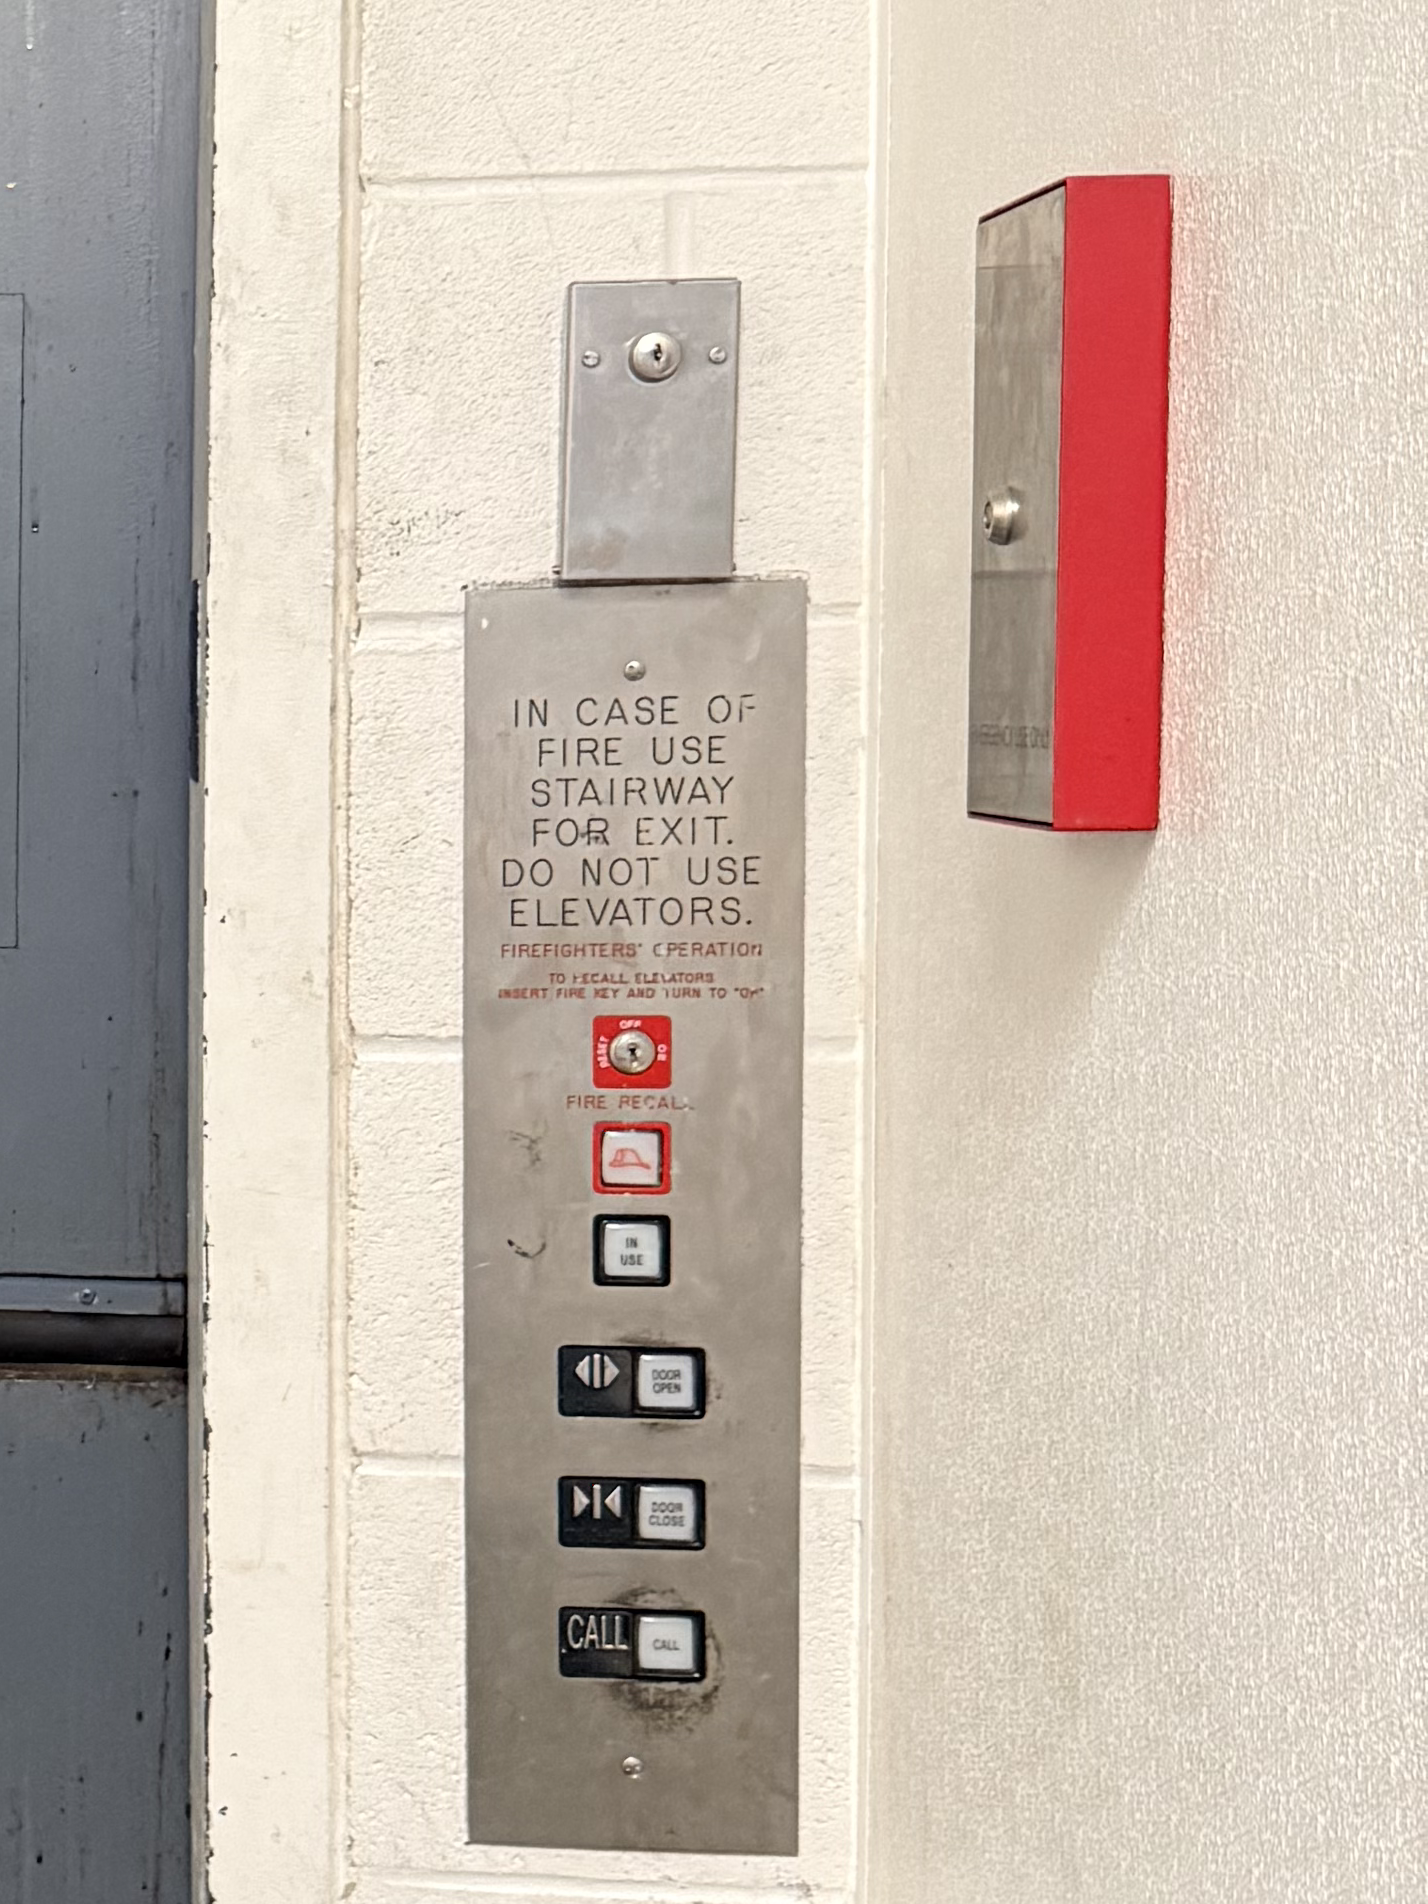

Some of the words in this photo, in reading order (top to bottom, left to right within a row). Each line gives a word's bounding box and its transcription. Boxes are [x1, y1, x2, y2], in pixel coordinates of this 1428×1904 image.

[514, 698, 548, 728] IN
[576, 695, 680, 727] CASE
[707, 693, 757, 724] OF
[538, 736, 624, 768] FIRE
[651, 734, 727, 766] USE
[531, 775, 735, 808] STAIRWAY
[532, 817, 610, 847] FOR
[635, 815, 734, 846] EXIT.
[502, 858, 554, 888] DO
[582, 856, 660, 887] NOT
[687, 855, 762, 886] USE
[510, 895, 753, 928] ELEVATORS.
[548, 972, 566, 985] TO
[555, 987, 587, 1000] FIRE
[626, 986, 656, 999] AND
[709, 986, 728, 999] TO
[566, 1095, 608, 1110] FIRE
[625, 1236, 638, 1248] IN
[620, 1253, 644, 1266] USE
[651, 1368, 682, 1381] DOOR
[652, 1382, 682, 1394] OPEN
[651, 1501, 683, 1514] DOOR
[648, 1514, 685, 1527] CLOSE
[566, 1613, 629, 1650] CALL
[652, 1638, 681, 1651] CALL
